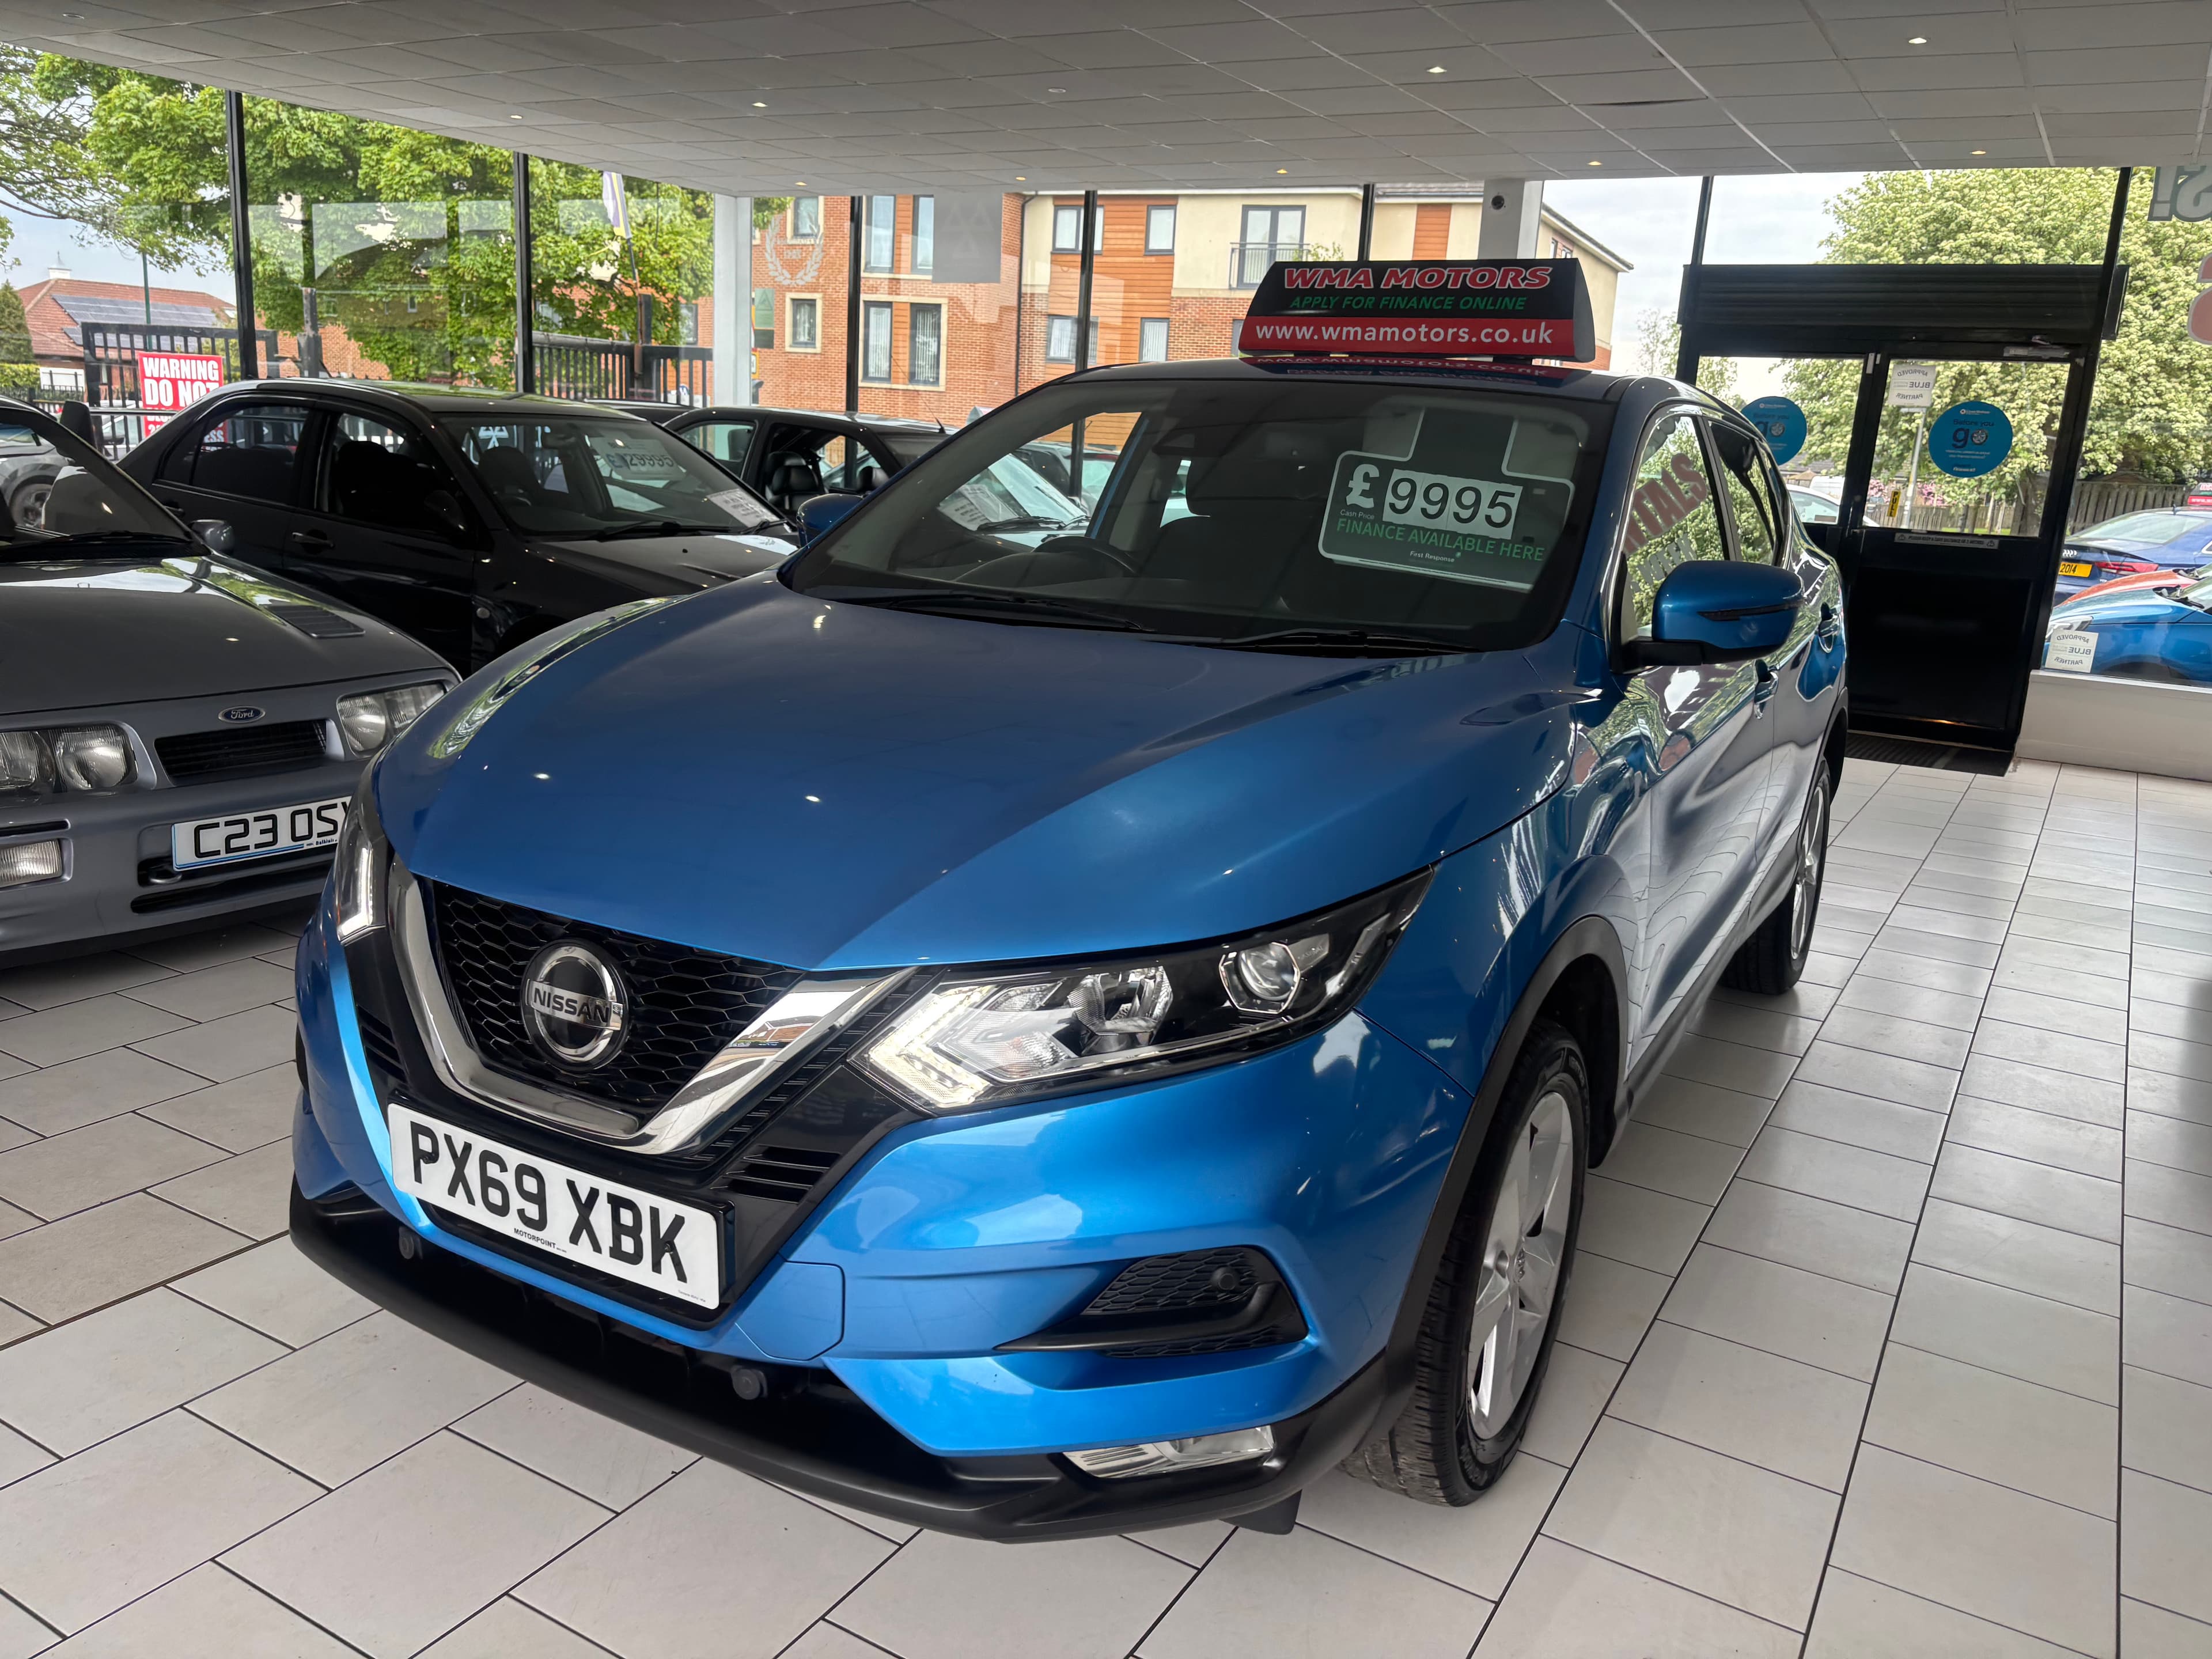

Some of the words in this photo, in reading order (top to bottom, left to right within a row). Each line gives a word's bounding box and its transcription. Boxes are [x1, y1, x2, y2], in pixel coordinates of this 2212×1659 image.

[1285, 267, 1374, 289] WMA
[1380, 266, 1554, 289] MOTORS
[1289, 296, 1338, 309] APPLY
[1342, 296, 1375, 309] FOR
[1378, 297, 1453, 310] FINANCE
[1459, 296, 1527, 310] ONLINE
[1256, 321, 1554, 344] www.wmamotors.co.uk
[142, 357, 219, 381] WARNING
[144, 378, 174, 407] DO
[1340, 509, 1357, 517] Cash
[1358, 512, 1375, 520] Price
[1889, 491, 1899, 517] PULL
[1336, 518, 1406, 541] FINANCE
[1408, 528, 1495, 554] AVAILABLE
[1499, 542, 1546, 562] HERE
[1410, 550, 1423, 558] First
[1425, 552, 1455, 563] Response
[230, 709, 254, 719] Ford
[194, 813, 278, 859] C23
[533, 987, 609, 1023] NISSAN
[410, 1121, 548, 1232] PX69
[566, 1178, 688, 1284] XBK
[514, 1228, 556, 1249] MOTORPOINT
